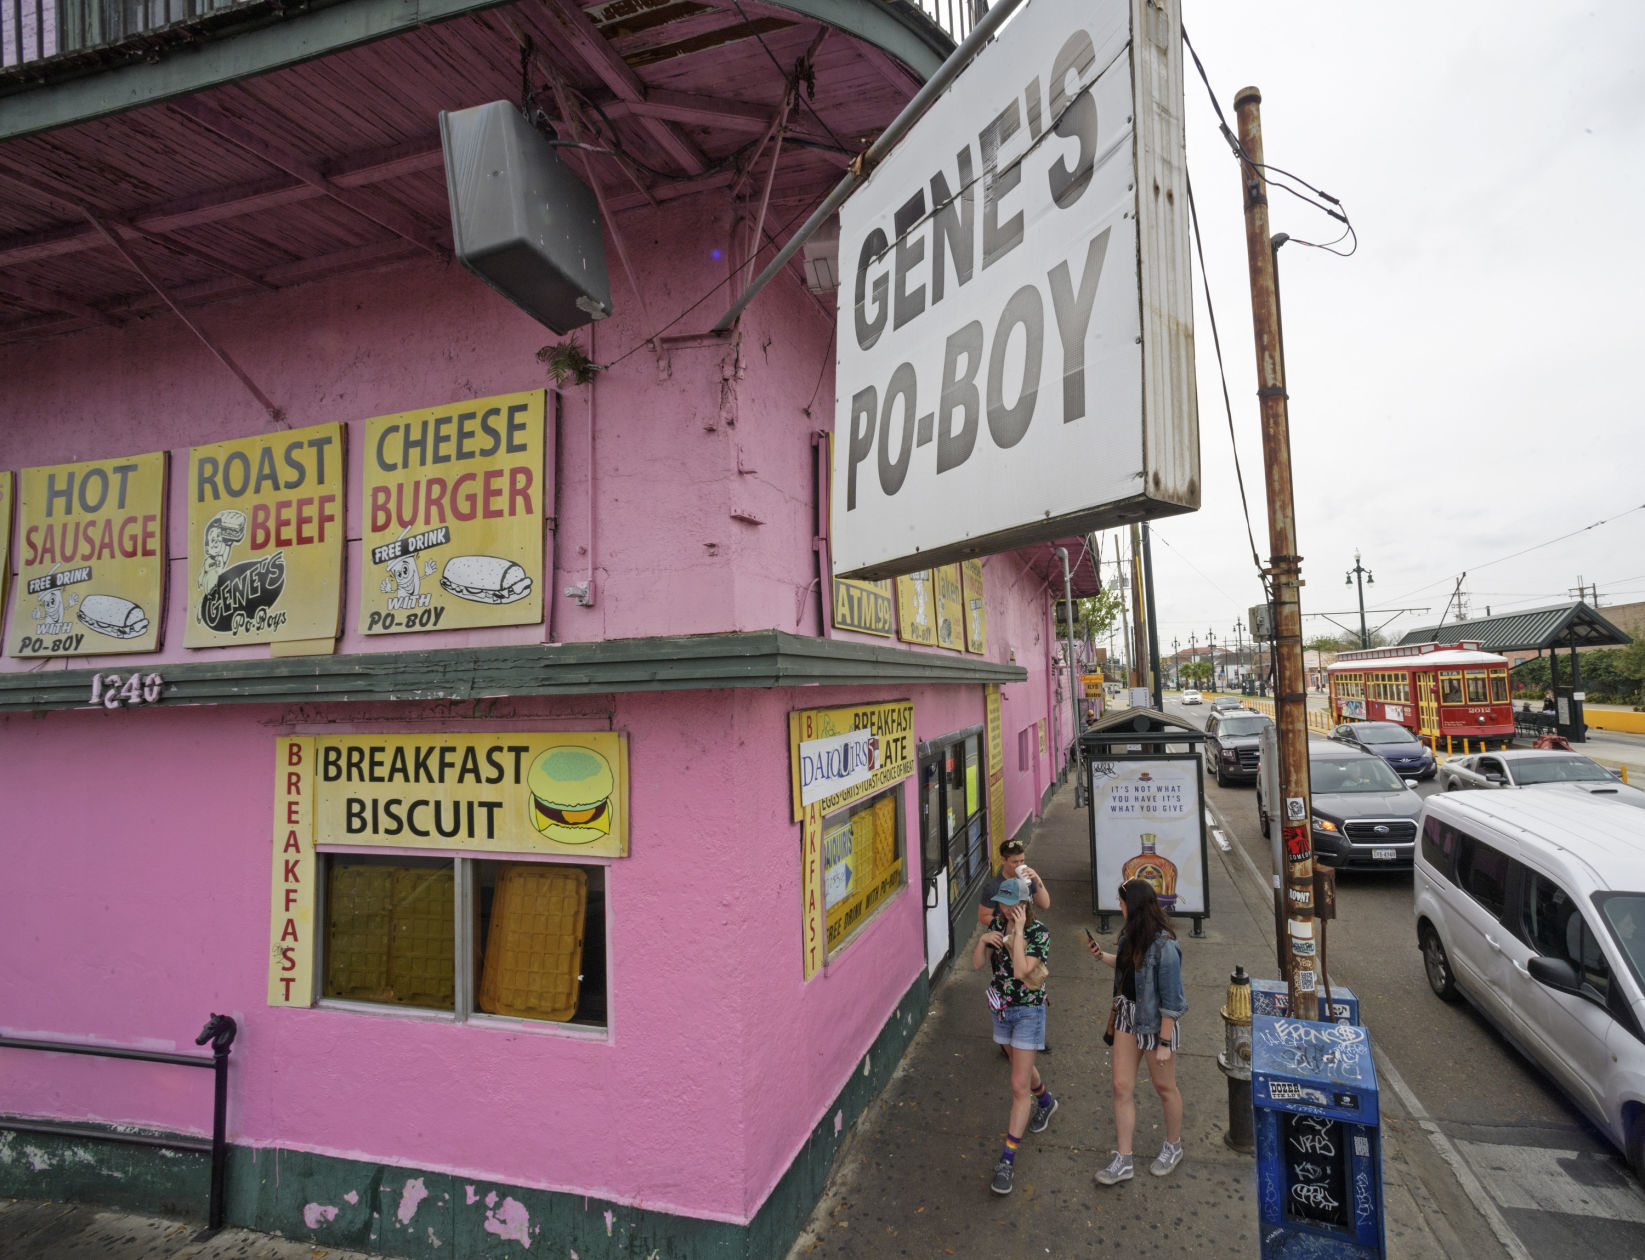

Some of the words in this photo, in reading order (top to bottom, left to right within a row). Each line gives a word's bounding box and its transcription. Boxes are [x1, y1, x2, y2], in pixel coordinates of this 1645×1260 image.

[854, 29, 1098, 351] GENE'S
[847, 226, 1112, 512] PO-BOY
[376, 404, 529, 472] CHEESE
[198, 437, 332, 502] ROAST
[46, 464, 137, 517] HOT
[371, 466, 533, 533] BURGER
[25, 514, 156, 566] SAUSAGE
[250, 495, 336, 550] BEEF
[375, 541, 402, 563] FREE
[408, 528, 446, 551] DRINK
[30, 574, 51, 593] FREE
[56, 567, 89, 585] DRINK
[206, 551, 285, 626] GENE'S
[367, 606, 445, 631] PO-BOY
[387, 593, 432, 611] WITH
[837, 584, 876, 630] ATM
[20, 634, 84, 653] PO-BOY
[37, 622, 72, 635] WITH
[88, 673, 163, 709] 1240
[854, 707, 913, 737] BREAKFAST
[323, 745, 529, 784] BREAKFAST
[880, 736, 907, 768] ATE
[346, 798, 503, 839] BISCUIT
[806, 715, 816, 971] BAKFAST
[280, 743, 302, 1002] BREAKFAST
[844, 900, 862, 930] DRINK
[1271, 1083, 1300, 1093] DOZER
